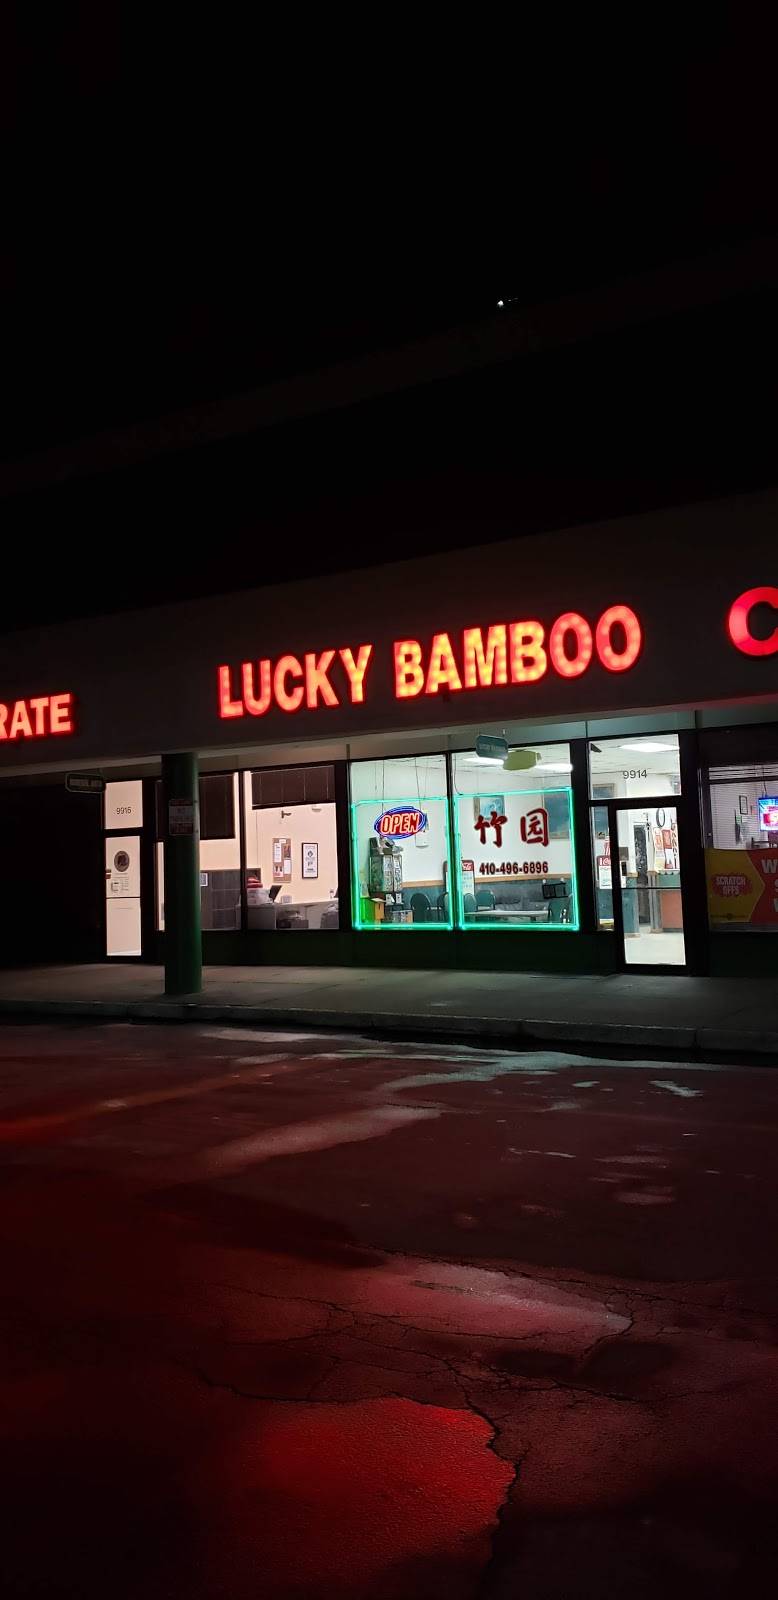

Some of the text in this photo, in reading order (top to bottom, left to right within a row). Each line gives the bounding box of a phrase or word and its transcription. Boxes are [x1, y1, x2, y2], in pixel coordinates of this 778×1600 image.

[218, 606, 642, 719] LUCKY BAMBOO
[622, 769, 648, 779] 9914
[380, 812, 420, 835] OPEN
[474, 808, 549, 849] 竹园
[479, 861, 549, 876] 410-496-6896
[715, 875, 746, 886] SCRATCH
[722, 885, 740, 896] OFFS
